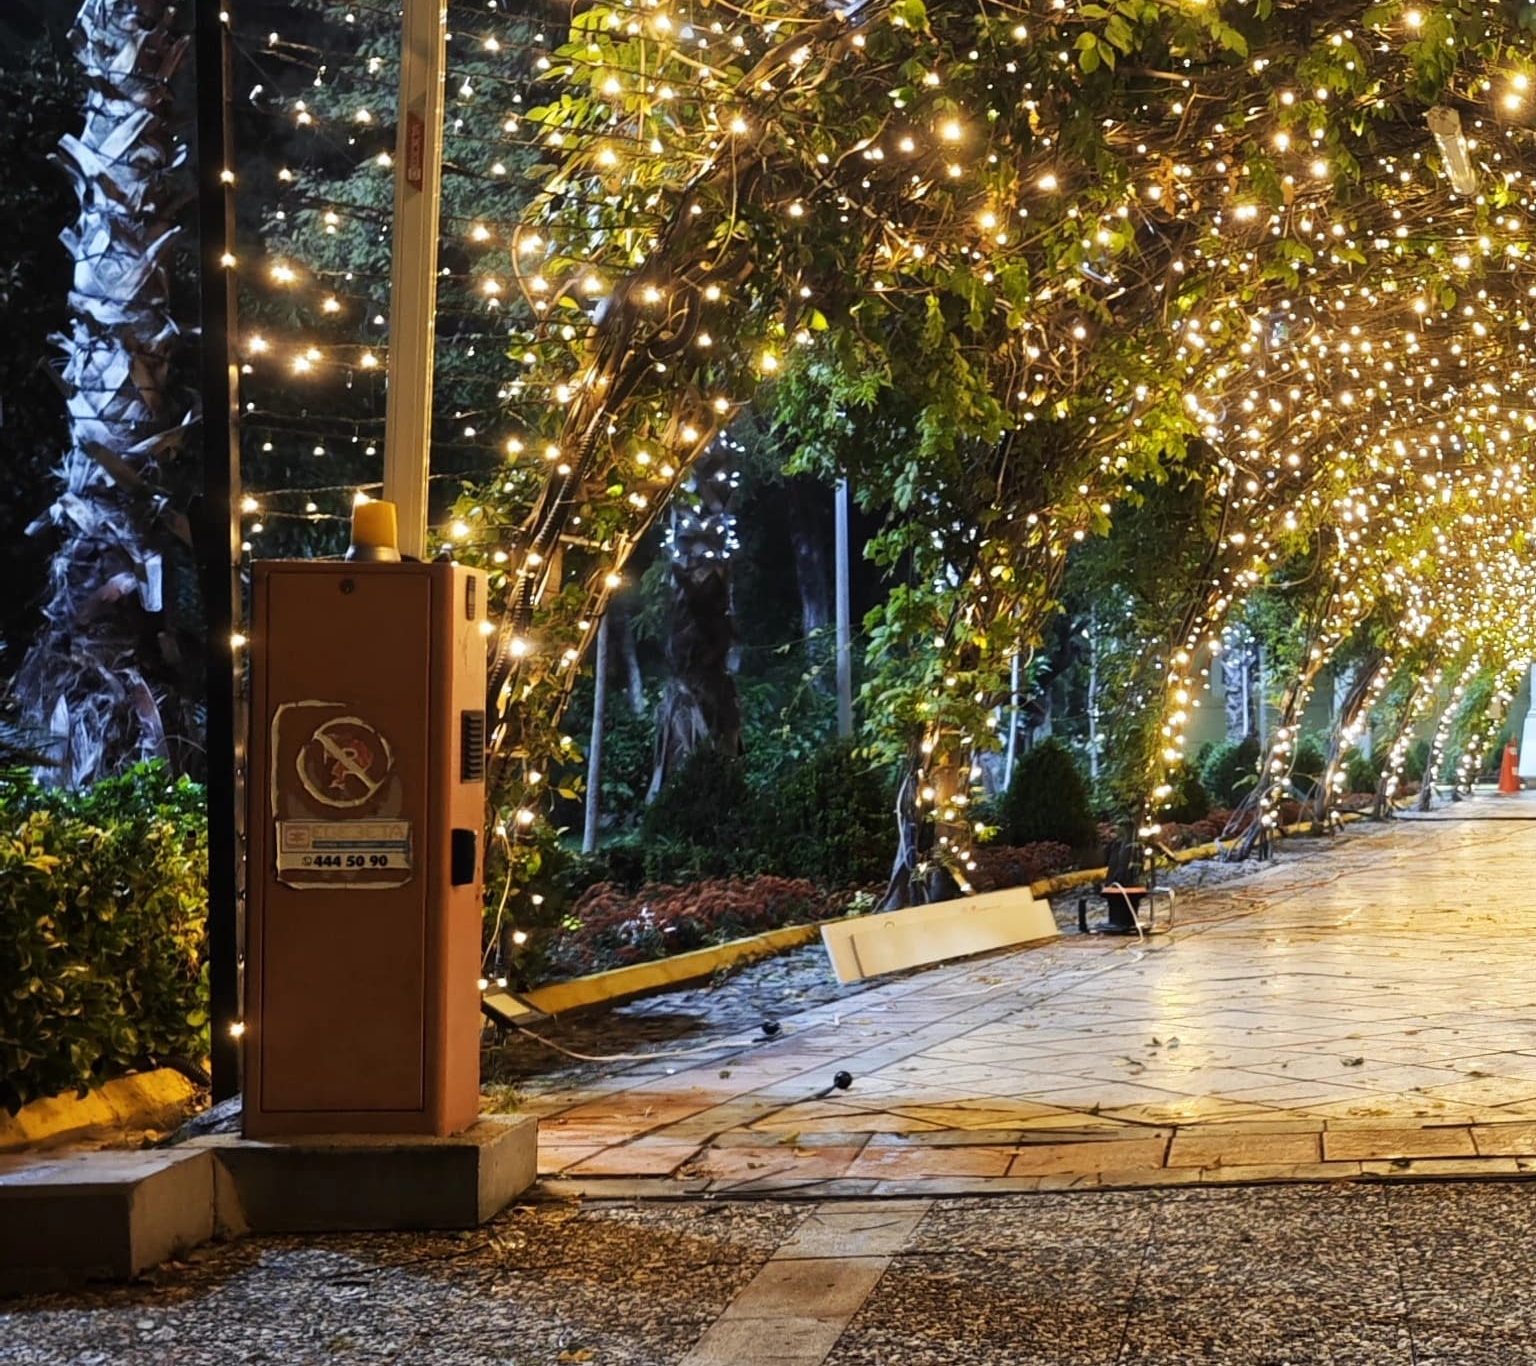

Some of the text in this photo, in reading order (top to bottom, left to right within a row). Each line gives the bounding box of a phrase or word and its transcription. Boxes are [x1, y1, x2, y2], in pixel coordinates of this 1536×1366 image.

[314, 855, 388, 867] 444 50 90
